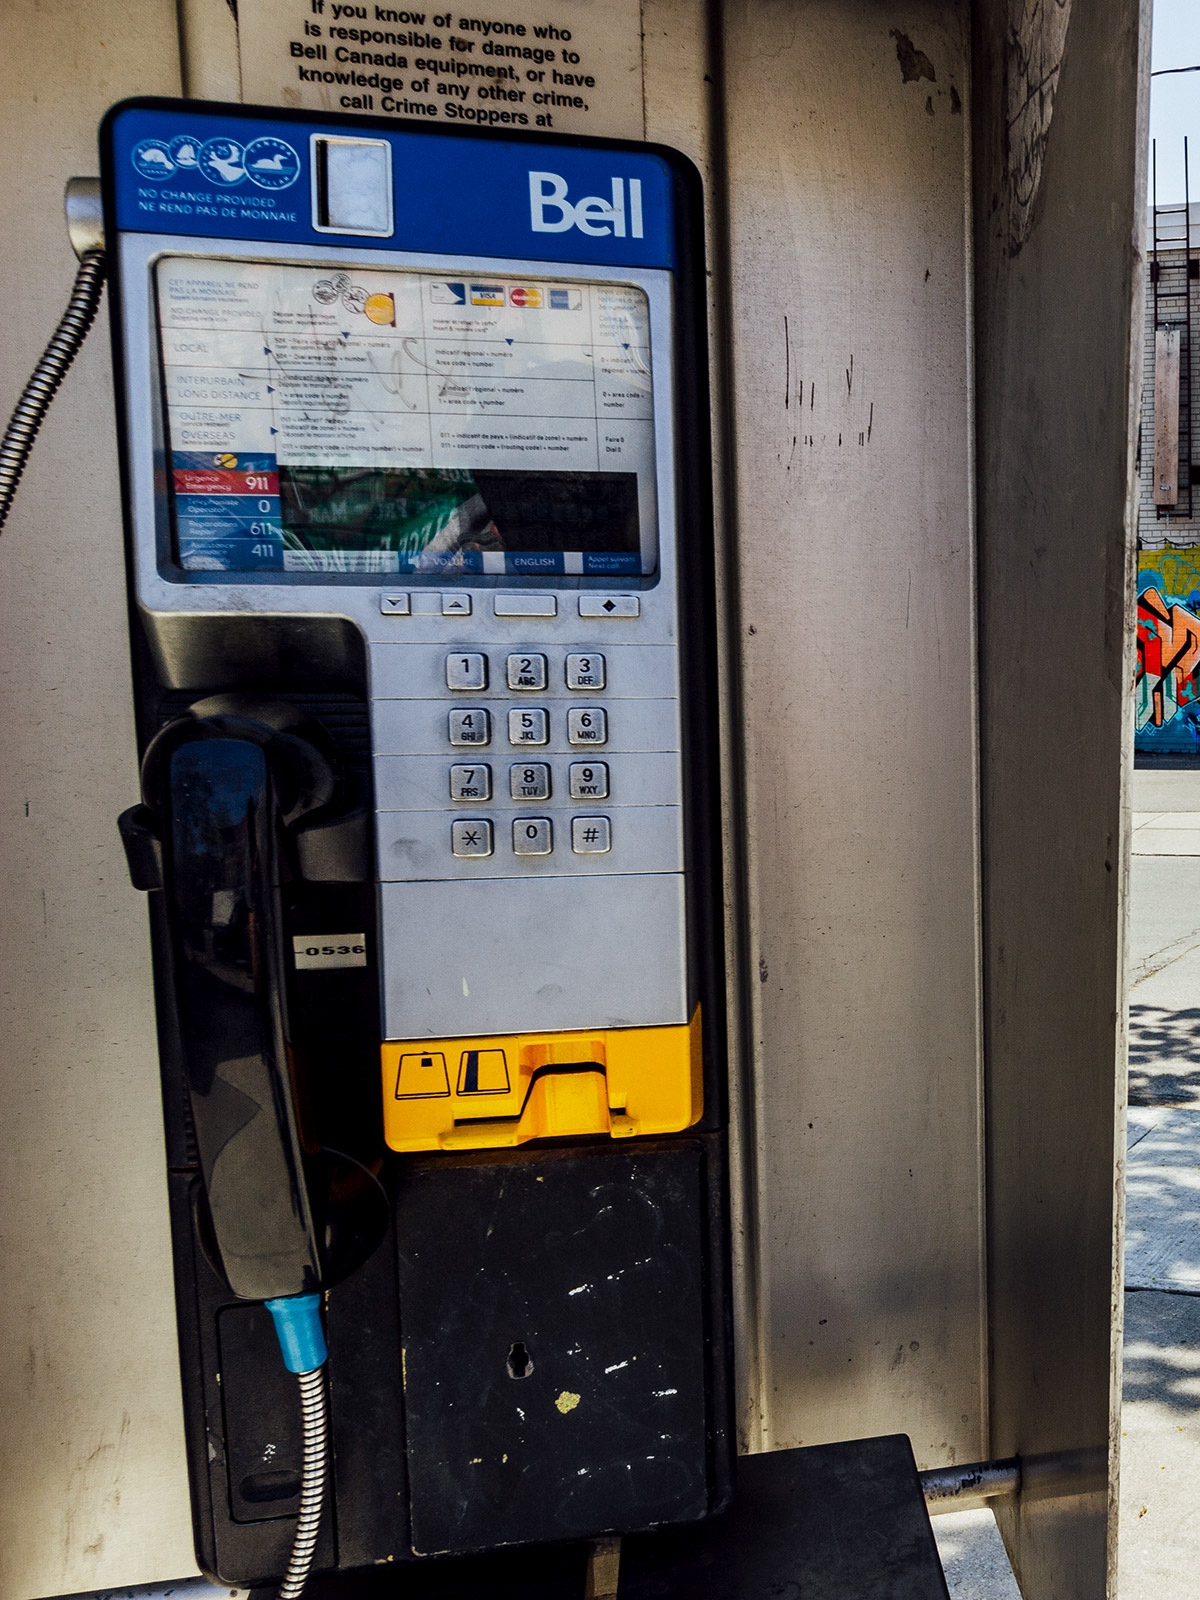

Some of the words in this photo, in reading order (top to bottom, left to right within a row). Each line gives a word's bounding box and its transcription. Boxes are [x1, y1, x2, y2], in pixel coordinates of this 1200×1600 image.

[312, 0, 324, 14] If
[331, 3, 367, 20] you
[375, 5, 426, 25] know
[433, 13, 452, 28] of
[459, 18, 526, 36] anyone
[533, 25, 571, 41] who
[304, 20, 322, 37] is
[329, 26, 442, 49] responsible
[449, 36, 475, 53] for
[482, 41, 555, 64] damage
[561, 49, 580, 64] to
[289, 41, 327, 61] Bell
[335, 47, 408, 69] Canada
[415, 57, 520, 83] equipment,
[526, 70, 546, 82] or
[552, 69, 595, 88] have
[298, 65, 404, 93] knowledge
[411, 78, 430, 93] of
[436, 82, 470, 101] any
[477, 85, 526, 102] other
[532, 91, 589, 111] crime,
[340, 94, 373, 110] call
[381, 96, 438, 116] Crime
[444, 102, 529, 125] Stoppers
[535, 113, 554, 127] at
[250, 140, 293, 157] CANADA
[253, 173, 291, 187] DOLLAR
[138, 188, 158, 199] NO
[160, 189, 213, 203] CHANGE
[216, 194, 276, 208] PROVIDED
[528, 171, 644, 238] Bell
[138, 201, 156, 212] NE
[159, 203, 193, 215] REND
[196, 206, 219, 217] PAS
[221, 208, 237, 218] DE
[241, 210, 298, 223] MONNAIE
[173, 343, 209, 353] LOCAL
[177, 375, 245, 386] INTERURBAIN
[178, 389, 208, 399] LONG
[211, 390, 262, 401] DISTANCE
[180, 411, 242, 422] OUTRE-MER
[181, 430, 236, 440] OVERSEAS
[184, 475, 220, 484] Urgence
[245, 476, 269, 490] 911
[185, 482, 232, 492] Emergency
[258, 499, 271, 513] 0
[250, 522, 273, 535] 611
[251, 544, 274, 557] 411
[433, 558, 473, 567] VOLUME
[514, 558, 555, 566] ENGLISH
[461, 658, 469, 673] 1
[520, 658, 532, 673] 2
[579, 658, 591, 673] 3
[518, 676, 536, 686] ABC
[577, 676, 594, 685] DEF
[461, 714, 474, 728] 4
[521, 713, 533, 728] 5
[580, 713, 592, 728] 6
[461, 731, 476, 741] GHI
[519, 731, 536, 740] JKL
[577, 731, 596, 740] MNO
[463, 770, 475, 784] 7
[523, 769, 535, 784] 8
[582, 768, 594, 782] 9
[461, 788, 478, 797] PRS
[579, 786, 598, 795] WXY
[526, 825, 538, 839] 0
